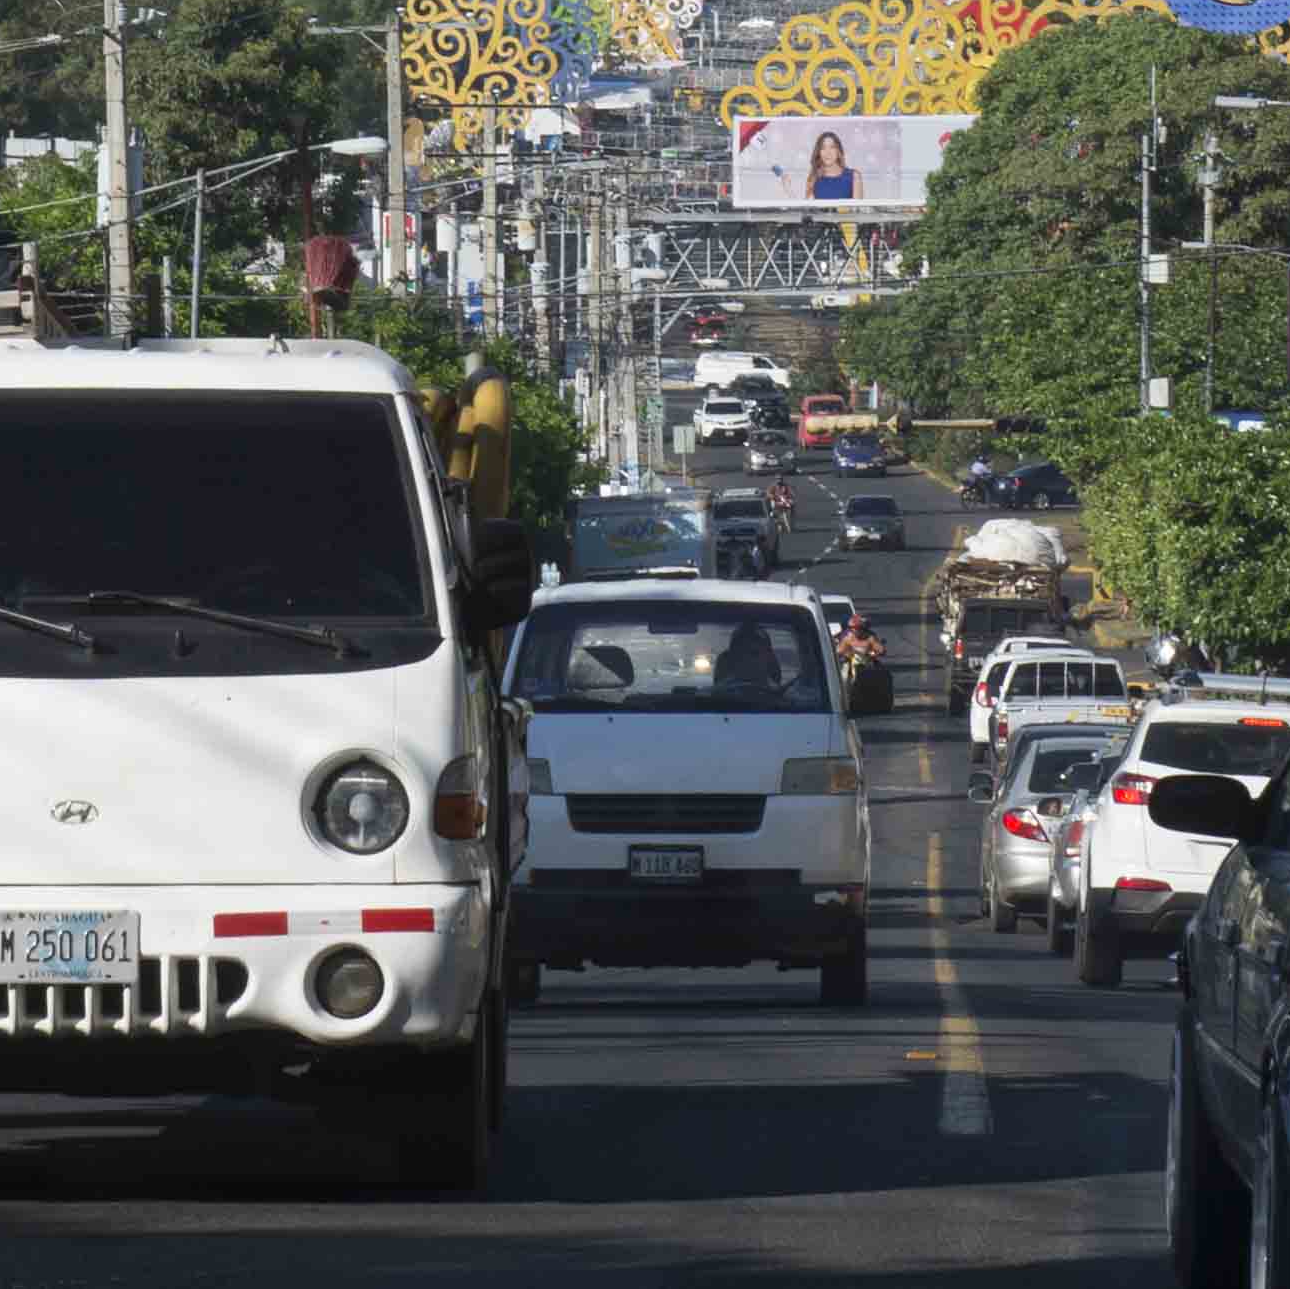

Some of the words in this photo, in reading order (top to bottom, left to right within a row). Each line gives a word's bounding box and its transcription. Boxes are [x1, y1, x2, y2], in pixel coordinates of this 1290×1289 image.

[1, 930, 14, 962] M
[26, 930, 73, 963] 250
[85, 930, 132, 963] 061
